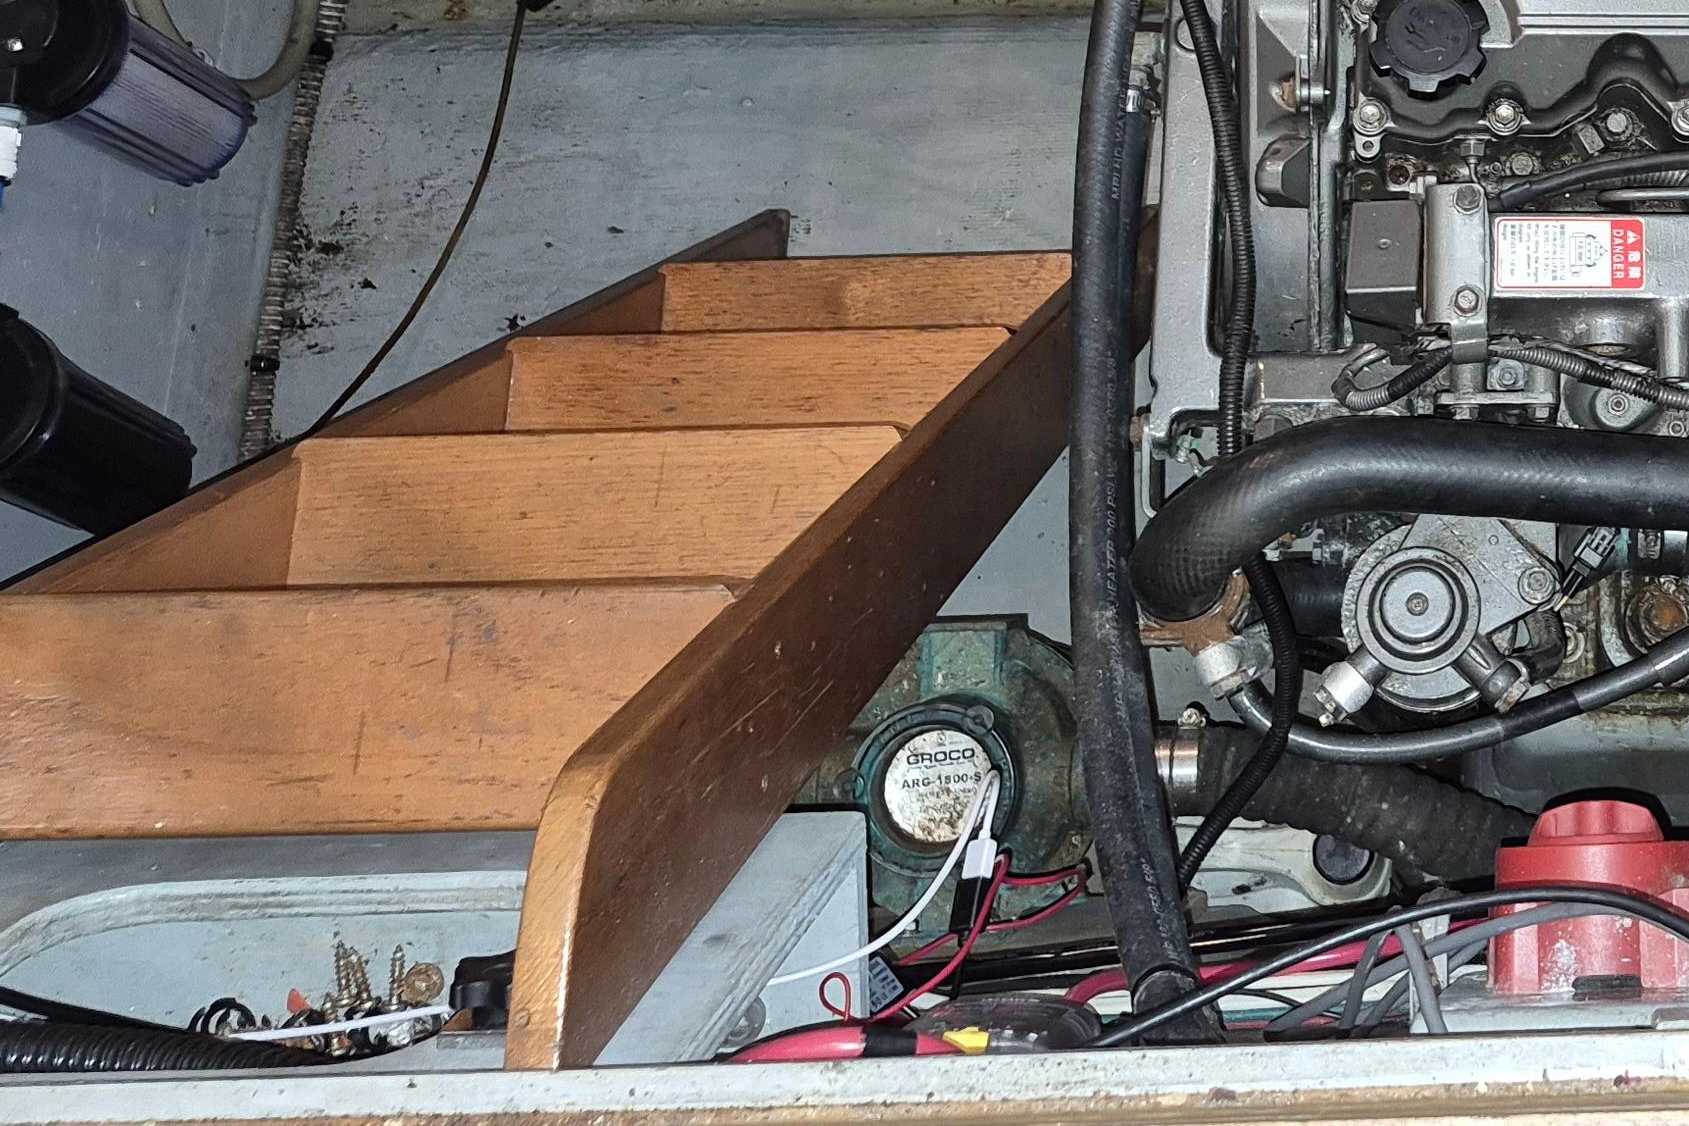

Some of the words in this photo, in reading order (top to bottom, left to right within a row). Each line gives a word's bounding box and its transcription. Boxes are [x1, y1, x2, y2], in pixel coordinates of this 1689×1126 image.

[1612, 229, 1625, 280] DANGER
[1104, 539, 1118, 602] HEATER
[906, 747, 975, 765] GROCO
